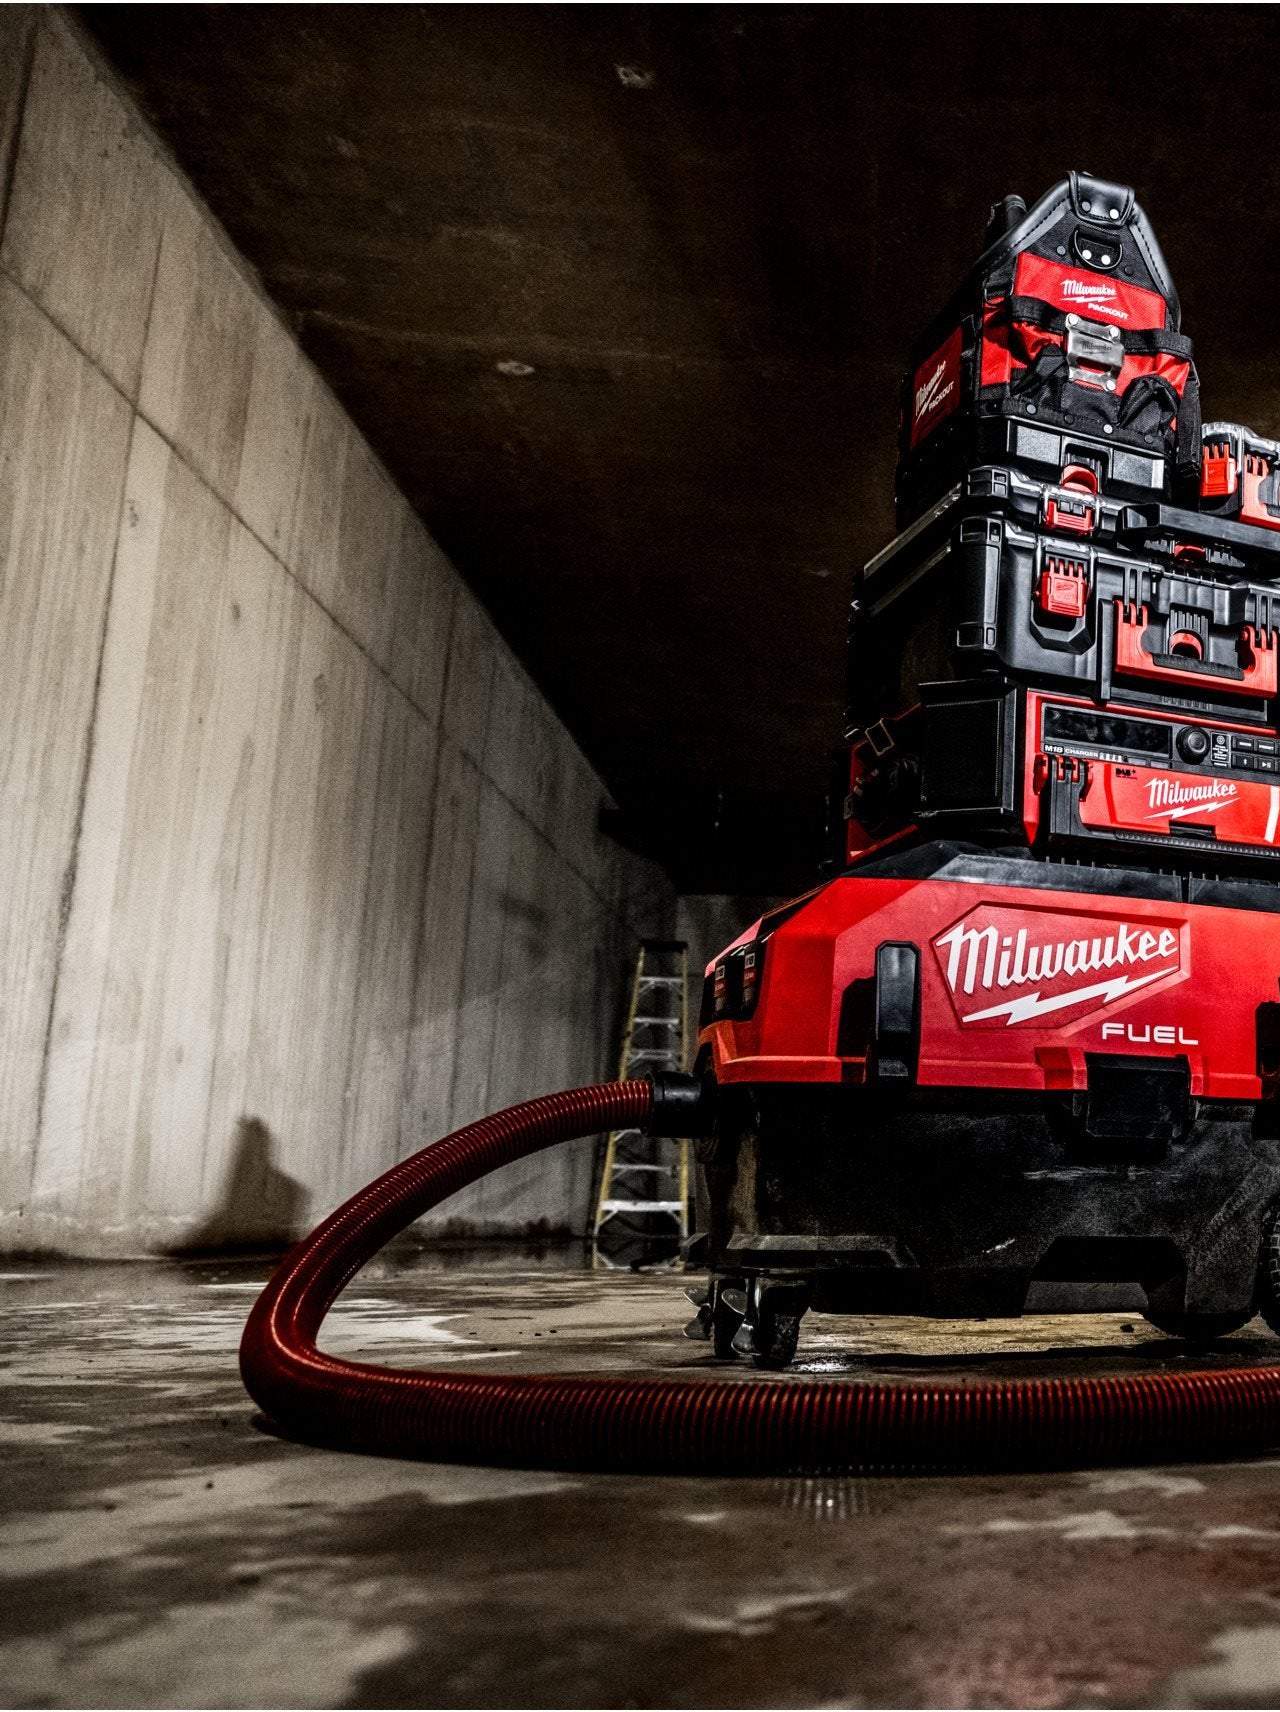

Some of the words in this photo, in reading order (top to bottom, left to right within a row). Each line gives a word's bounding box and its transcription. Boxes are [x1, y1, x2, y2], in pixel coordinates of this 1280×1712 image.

[1060, 279, 1117, 296] Milwaukee
[1087, 303, 1129, 319] PACKOUT
[1044, 745, 1064, 754] M18
[1065, 748, 1099, 758] CHARGER
[1143, 777, 1238, 809] Milwaukee
[935, 922, 1178, 996] Milwaukee
[1101, 1022, 1199, 1046] FUEL
